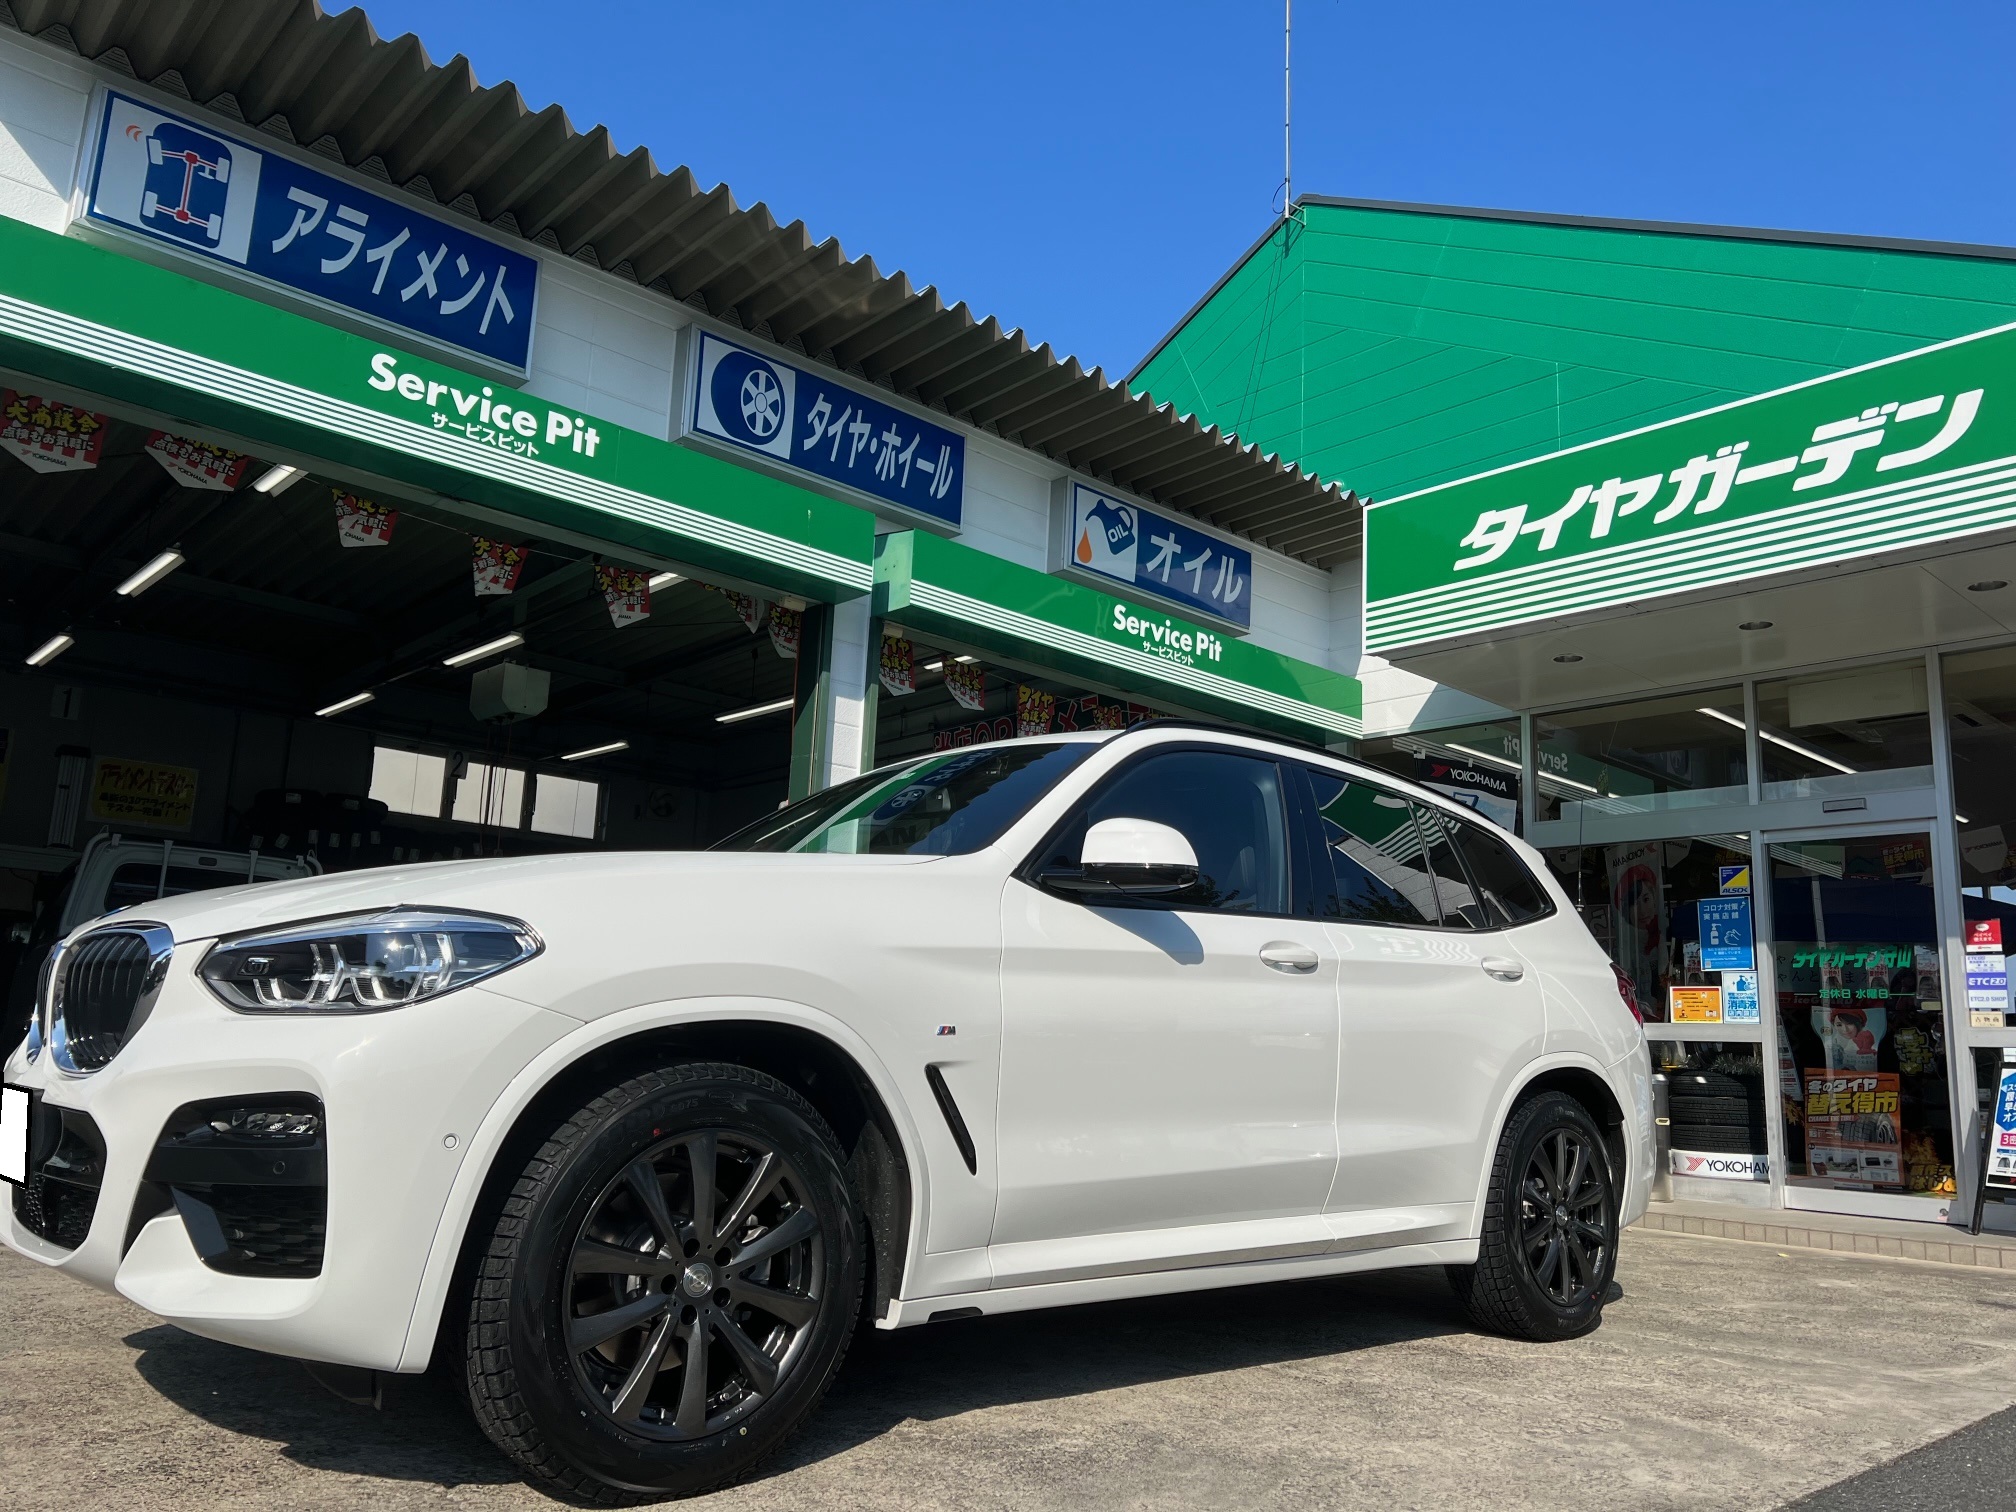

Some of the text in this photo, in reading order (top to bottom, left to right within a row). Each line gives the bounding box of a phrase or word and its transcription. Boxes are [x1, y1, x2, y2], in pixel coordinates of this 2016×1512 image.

[271, 185, 515, 335] アライメント
[366, 352, 601, 458] Service Pit
[431, 411, 541, 457] サービスピット
[803, 392, 955, 500] タイヤ・ホイール
[32, 452, 67, 467] YOKOHAMA
[1452, 388, 1985, 571] タイヤガーデン
[1106, 521, 1130, 544] OIL
[1146, 531, 1244, 603] オイル
[1112, 603, 1223, 664] Service Pit
[1142, 639, 1195, 667] サービスピット
[1018, 683, 1055, 709] タイヤ
[450, 750, 465, 778] 2
[1449, 767, 1508, 793] YOKOHAMA
[1721, 886, 1749, 894] ALSOK
[1728, 999, 1758, 1010] 消毒液
[1819, 988, 1890, 1000] 定休日 水曜日
[1808, 1079, 1878, 1094] 冬のタイヤ
[1807, 1091, 1899, 1116] 替え得市
